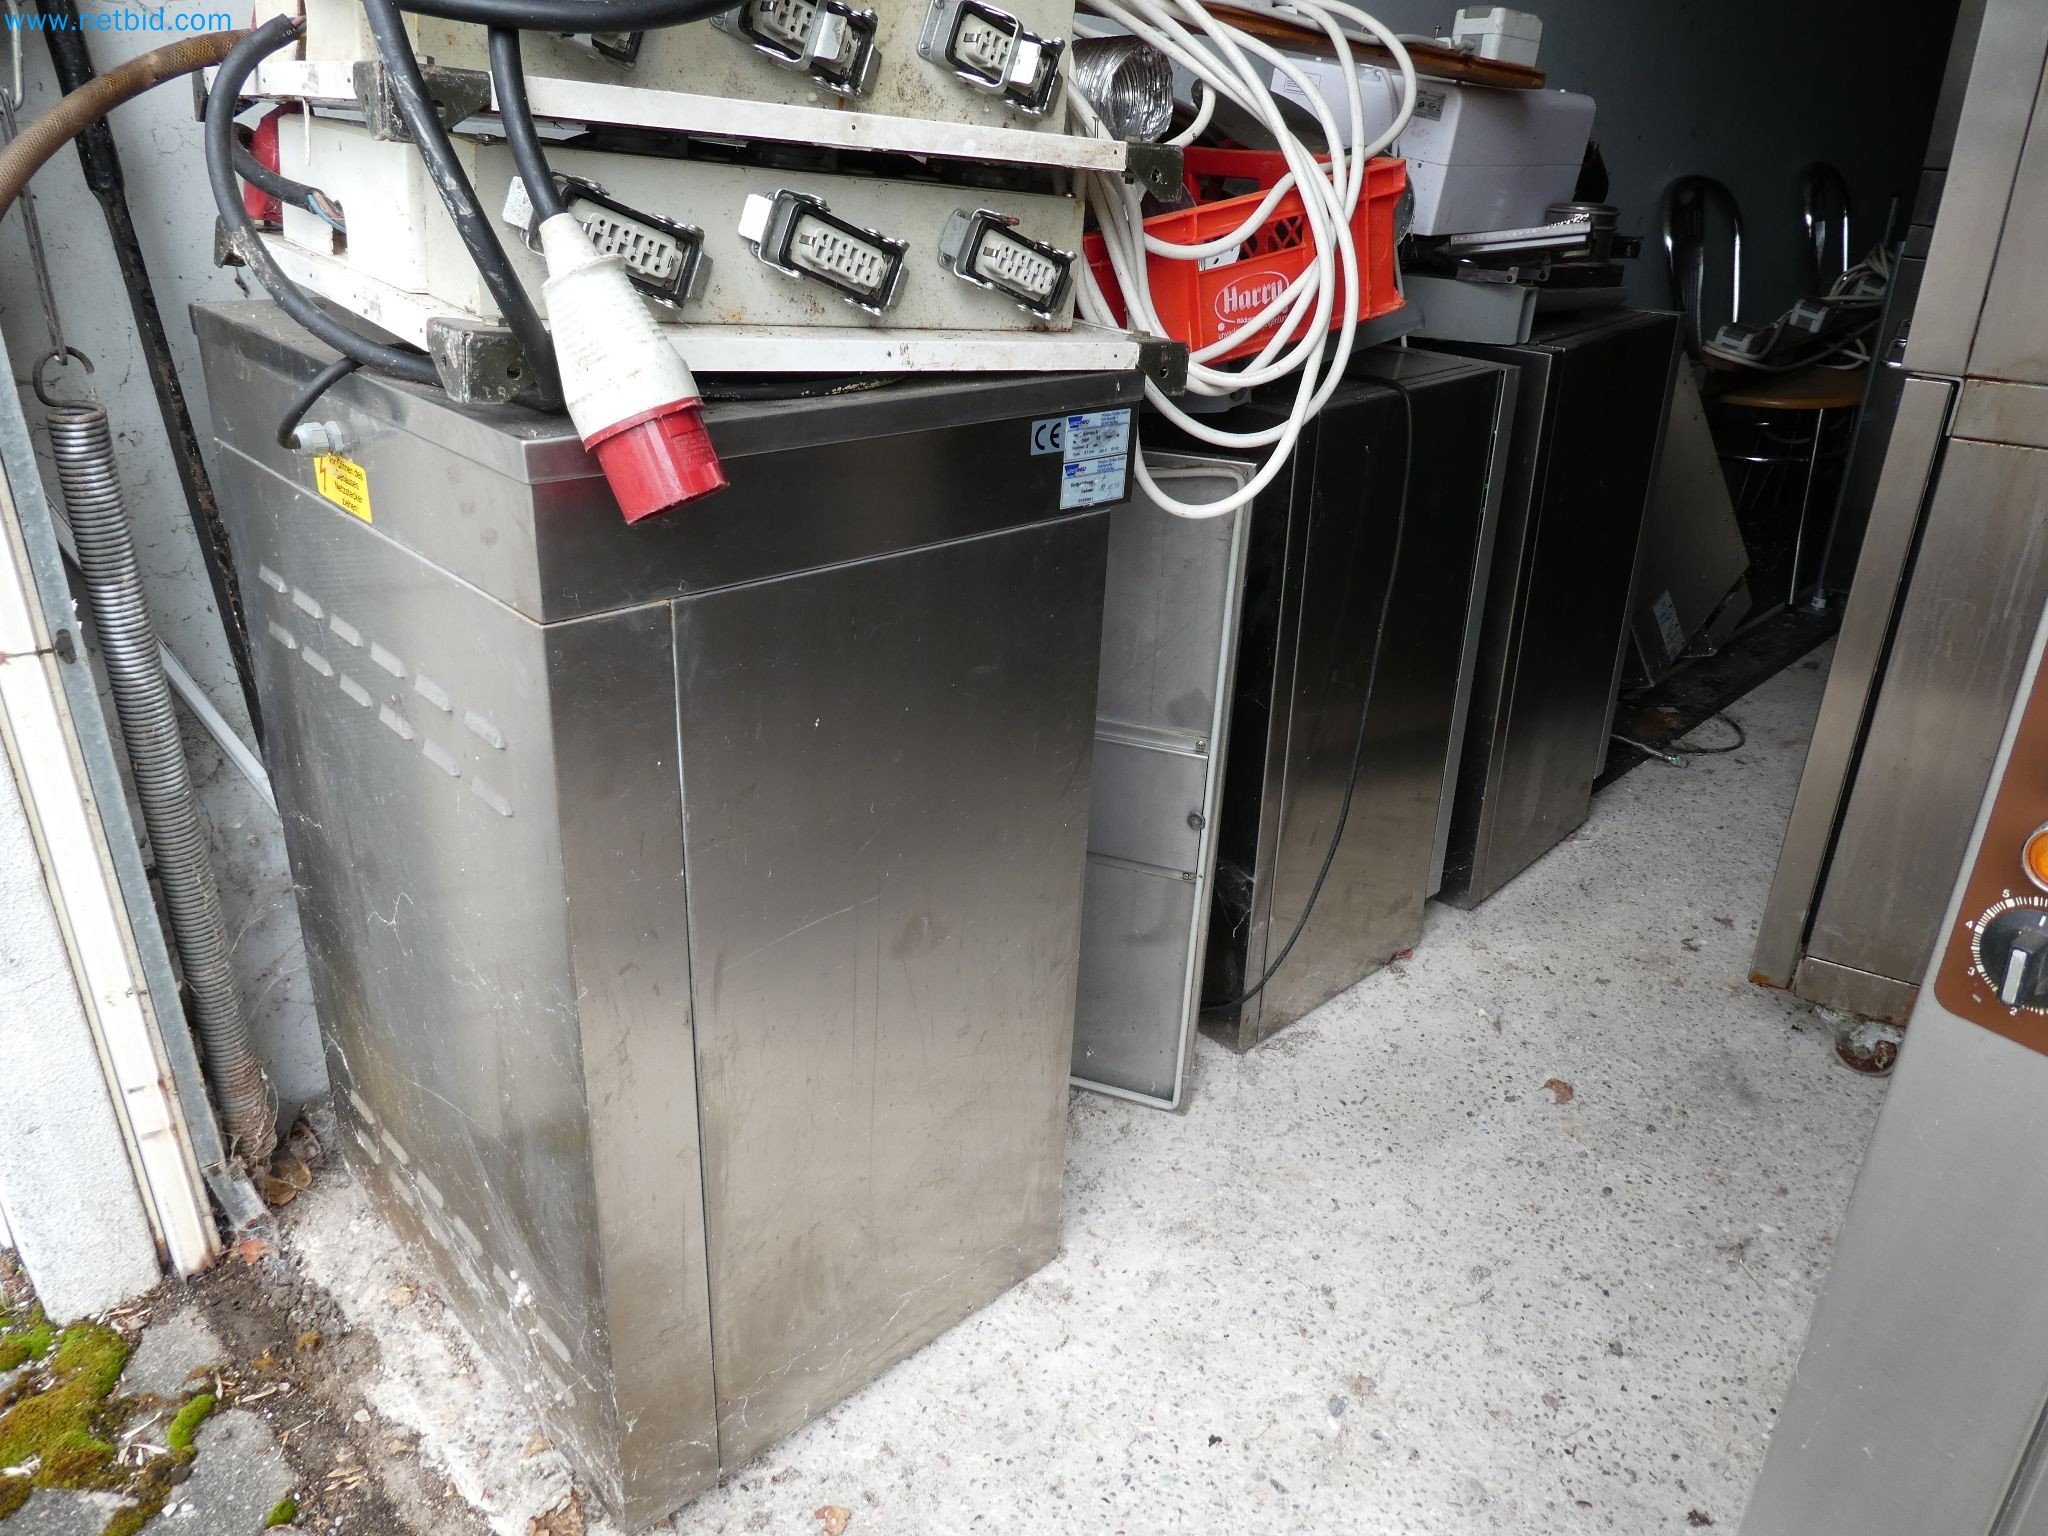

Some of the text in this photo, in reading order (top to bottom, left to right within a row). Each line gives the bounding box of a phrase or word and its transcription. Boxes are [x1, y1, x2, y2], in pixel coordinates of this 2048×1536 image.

[2002, 888, 2010, 898] 5
[1965, 920, 1973, 929] 4
[1967, 966, 1976, 976] 3
[2009, 1006, 2018, 1016] 2
